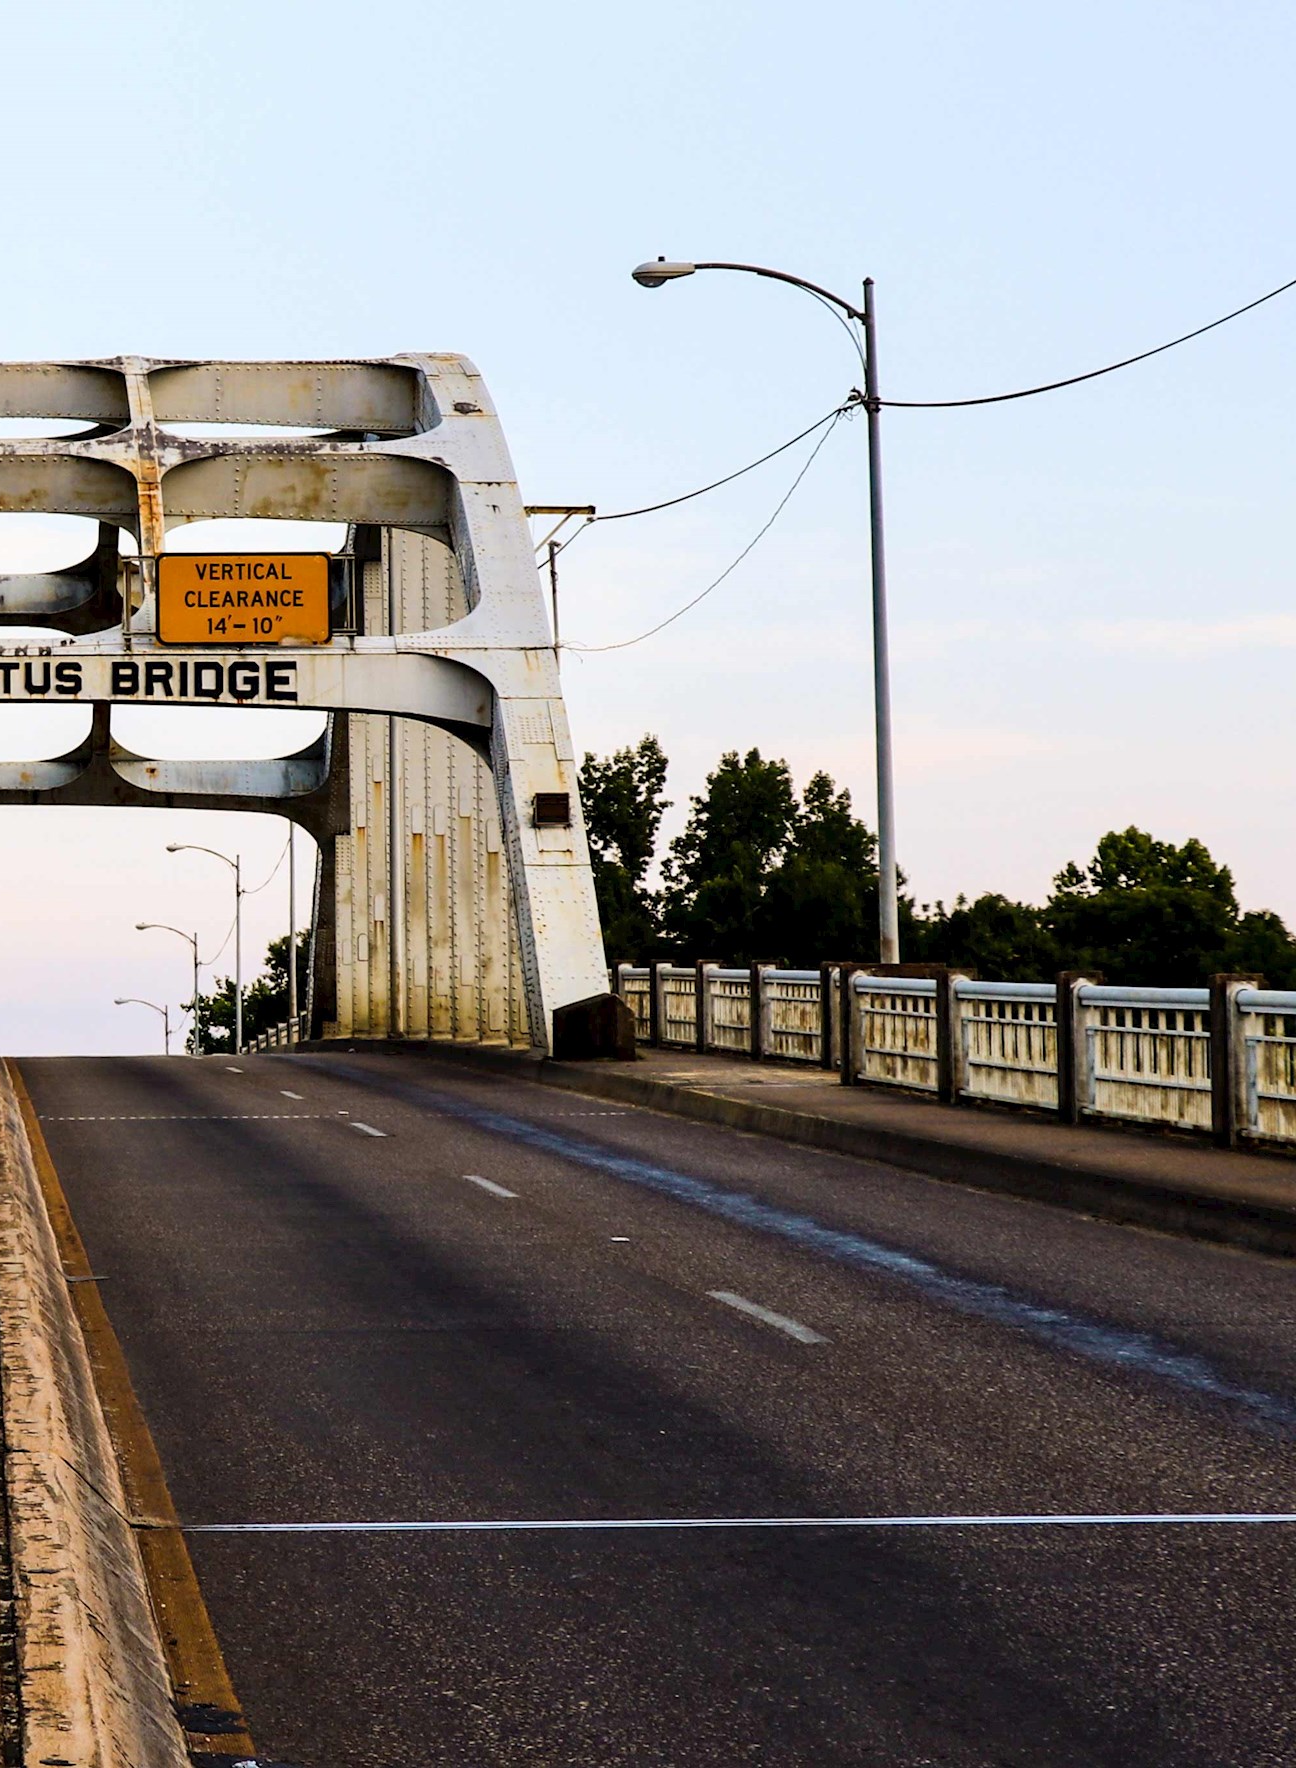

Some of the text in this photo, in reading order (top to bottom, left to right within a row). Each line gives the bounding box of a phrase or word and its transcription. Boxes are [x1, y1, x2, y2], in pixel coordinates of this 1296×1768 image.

[195, 563, 292, 581] VERTICAL
[184, 590, 304, 608] CLEARANCE
[111, 661, 298, 701] BRIDGE
